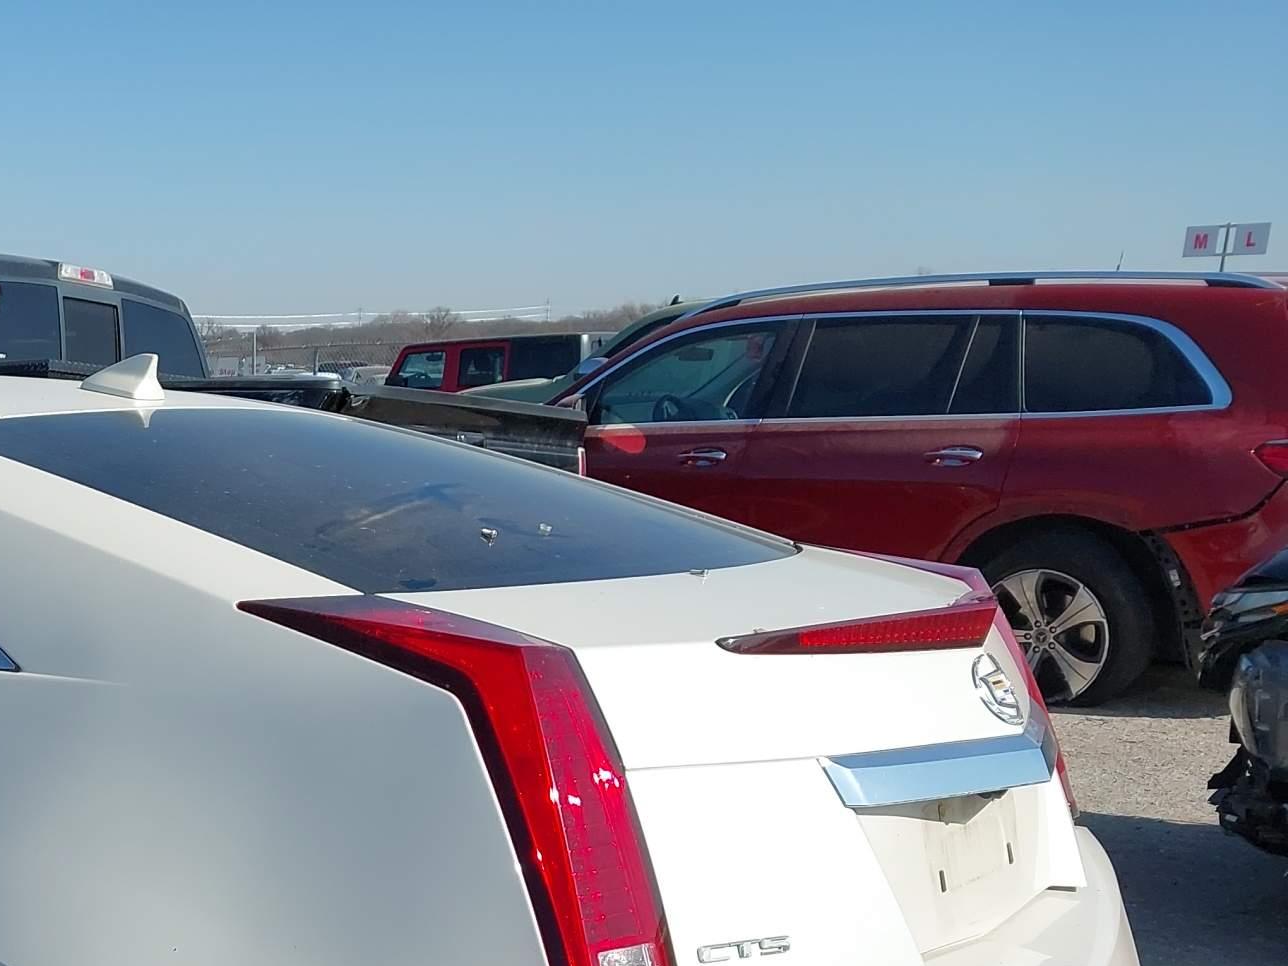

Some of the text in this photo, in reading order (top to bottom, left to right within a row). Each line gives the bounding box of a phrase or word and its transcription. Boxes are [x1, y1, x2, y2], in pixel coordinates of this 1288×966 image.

[1194, 233, 1209, 249] M
[1245, 231, 1257, 248] L
[697, 935, 791, 963] CTS
